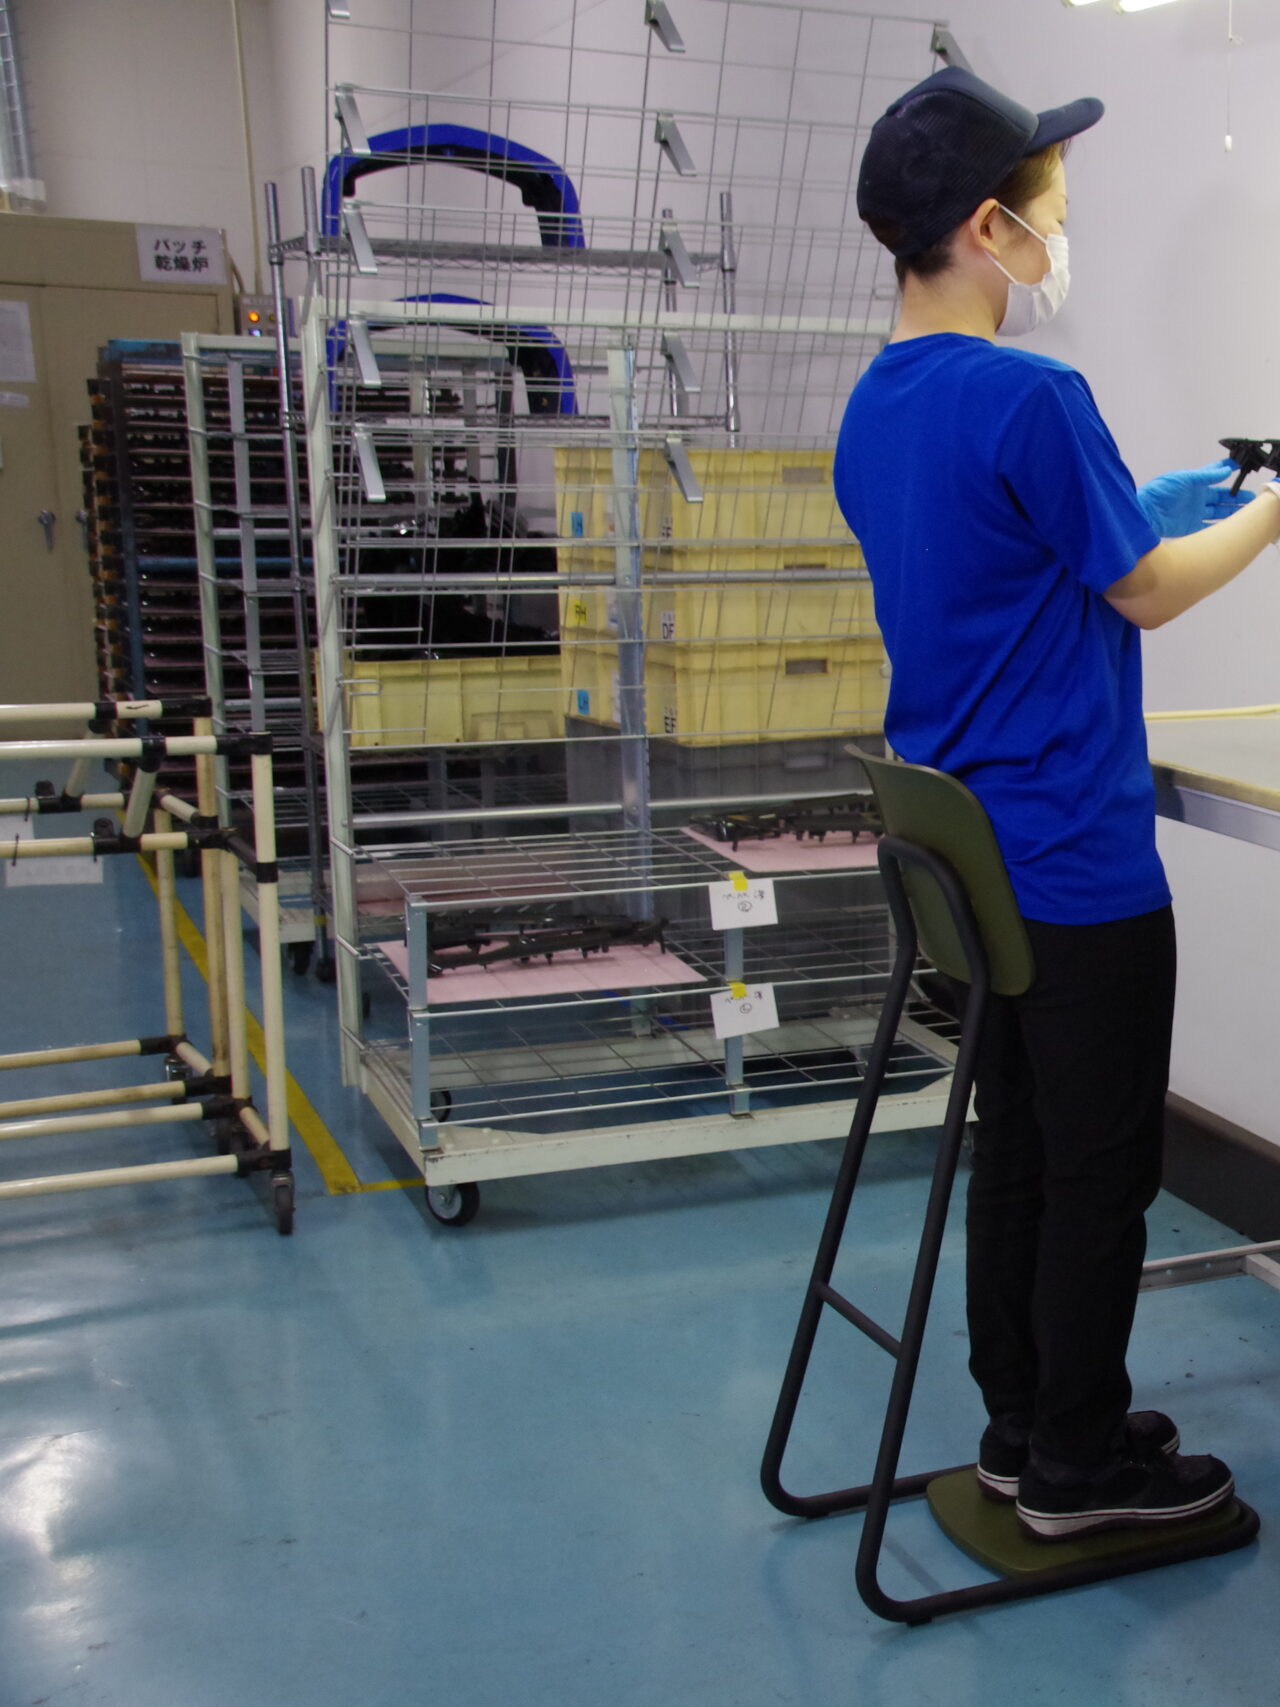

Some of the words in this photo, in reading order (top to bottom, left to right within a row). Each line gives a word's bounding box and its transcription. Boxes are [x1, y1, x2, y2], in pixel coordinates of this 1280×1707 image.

[154, 239, 207, 254] バッチ
[154, 255, 209, 272] 乾燥炉
[662, 622, 675, 640] DF
